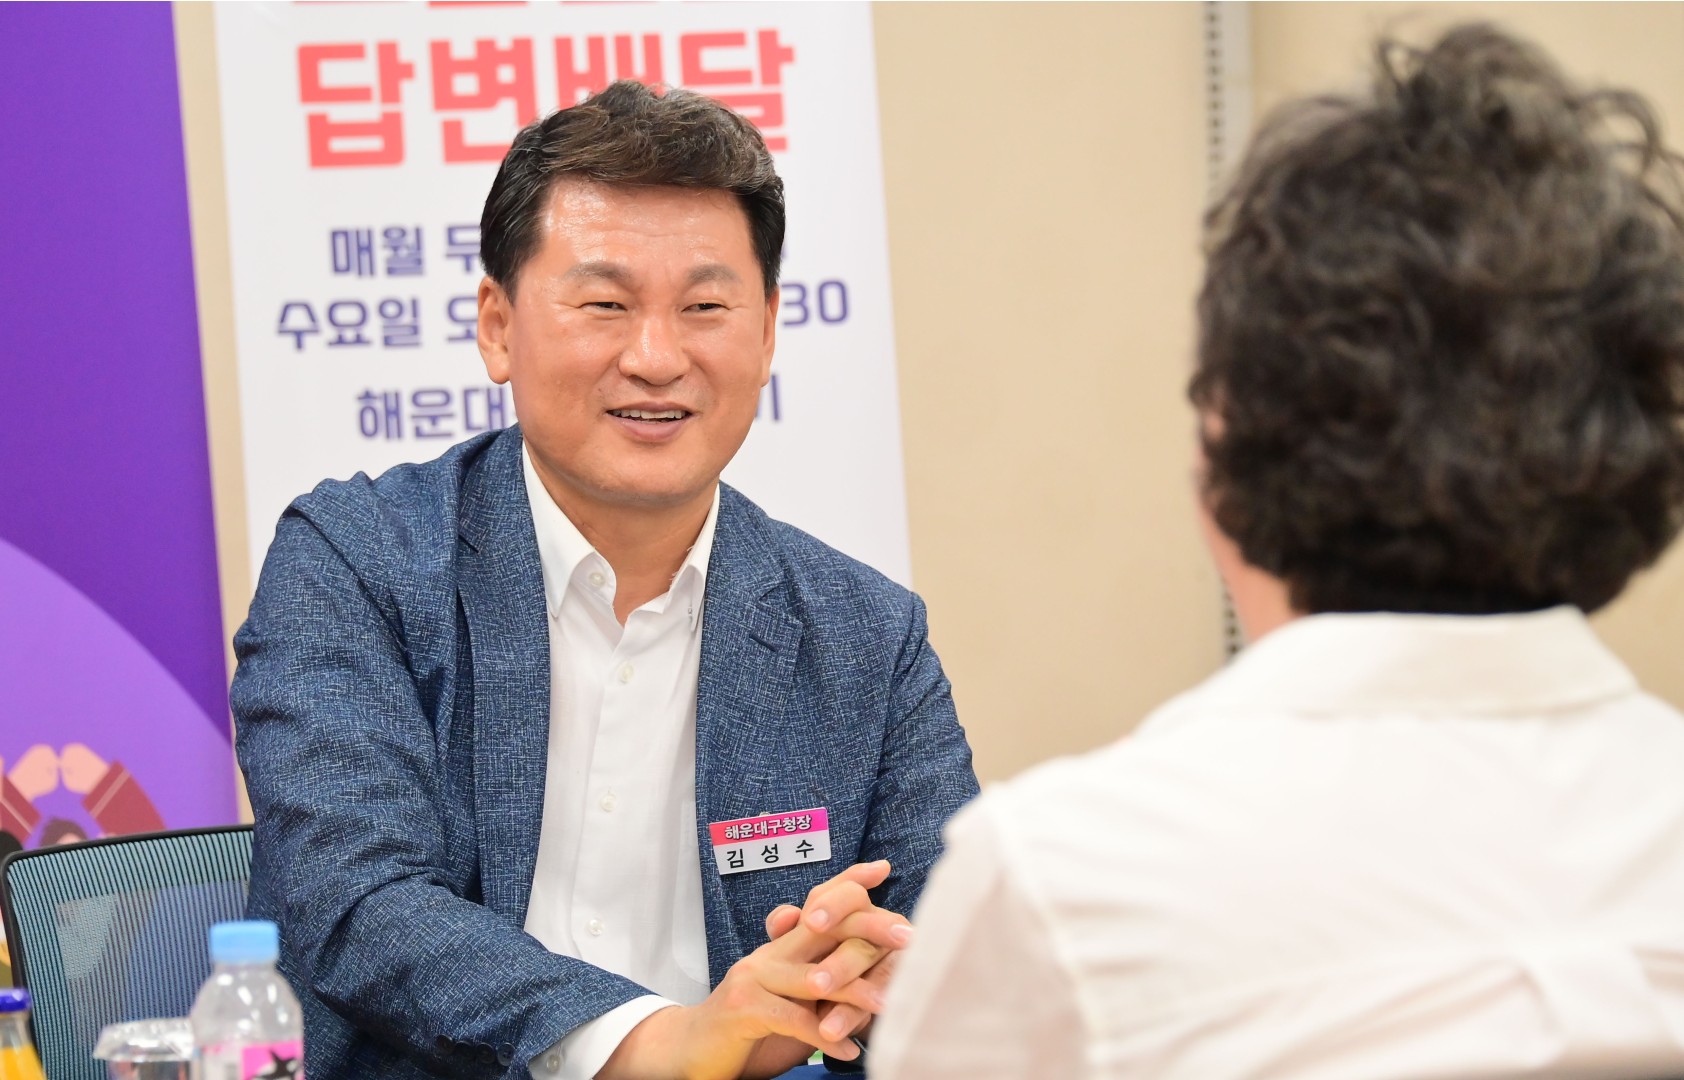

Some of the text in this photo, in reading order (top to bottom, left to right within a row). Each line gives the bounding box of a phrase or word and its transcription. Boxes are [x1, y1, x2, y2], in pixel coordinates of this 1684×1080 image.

[330, 226, 424, 277] 매월
[278, 298, 422, 350] 수요일
[356, 387, 510, 440] 해운대
[724, 814, 812, 840] 해운대구청장
